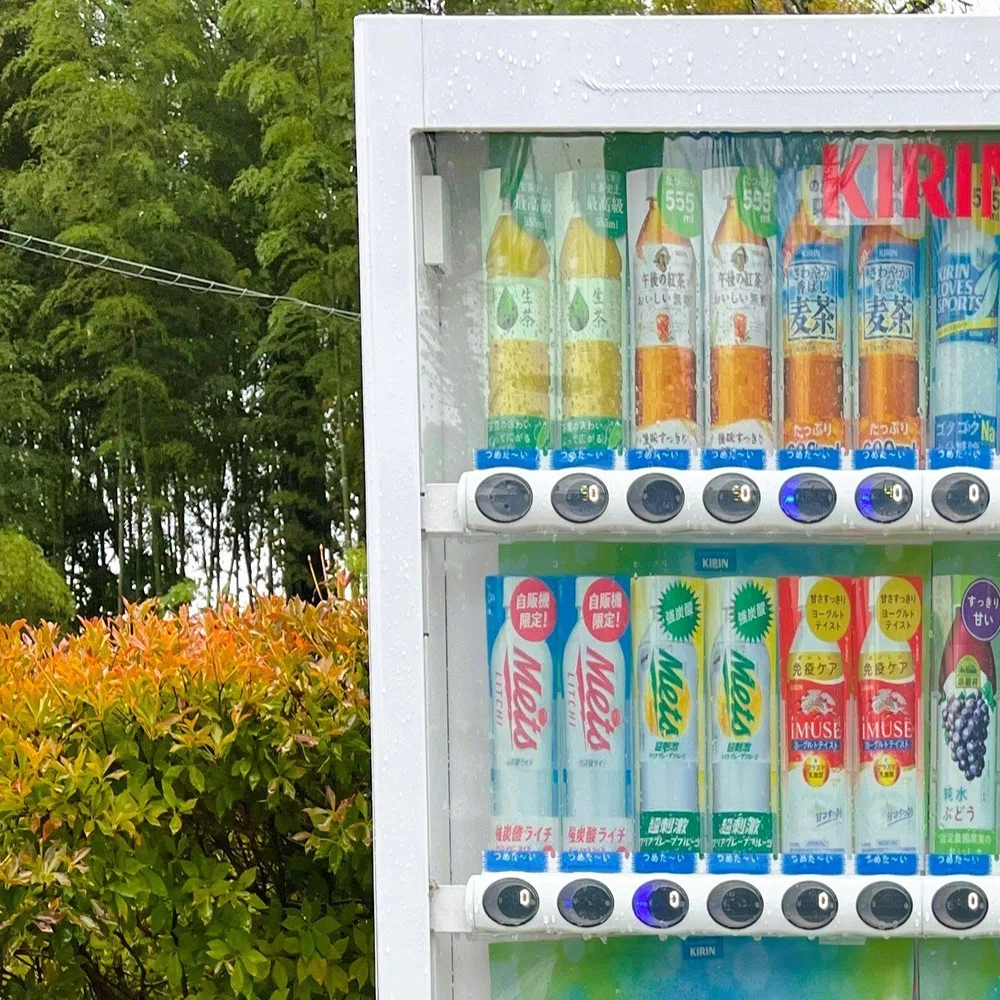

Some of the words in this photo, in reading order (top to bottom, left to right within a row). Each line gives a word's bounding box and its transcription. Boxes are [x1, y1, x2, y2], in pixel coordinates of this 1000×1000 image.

[665, 191, 695, 213] 555
[743, 190, 771, 213] 555
[937, 264, 969, 283] KIRIN
[937, 279, 973, 298] LOVES
[520, 288, 536, 327] 生茶
[937, 296, 985, 314] SPORTS
[788, 298, 836, 335] 麦茶
[863, 298, 912, 335] 麦茶
[702, 558, 729, 569] KIRIN
[515, 591, 550, 610] 自販機
[588, 591, 622, 610] 自販機
[810, 593, 846, 605] 甘さすっきり
[880, 593, 917, 605] 甘さすっきり
[968, 595, 1000, 609] すっきり
[811, 610, 845, 620] ヨーグルト
[881, 610, 915, 620] ヨーグルト
[973, 612, 994, 627] 甘い
[815, 621, 842, 631] テイスト
[885, 621, 912, 631] テイスト
[793, 661, 837, 677] 免疫ケア
[863, 661, 907, 677] 免疫ケア
[512, 646, 548, 751] Mets
[586, 646, 621, 751] Mets
[657, 649, 683, 738] Mets
[730, 650, 756, 738] Mets
[791, 716, 841, 739] iMUSE
[862, 716, 912, 739] iMUSE
[943, 787, 967, 801] 純水
[942, 805, 976, 822] ぶどう
[648, 817, 689, 835] 超刺激
[719, 817, 761, 836] 超刺激
[690, 946, 716, 957] KIRIN
